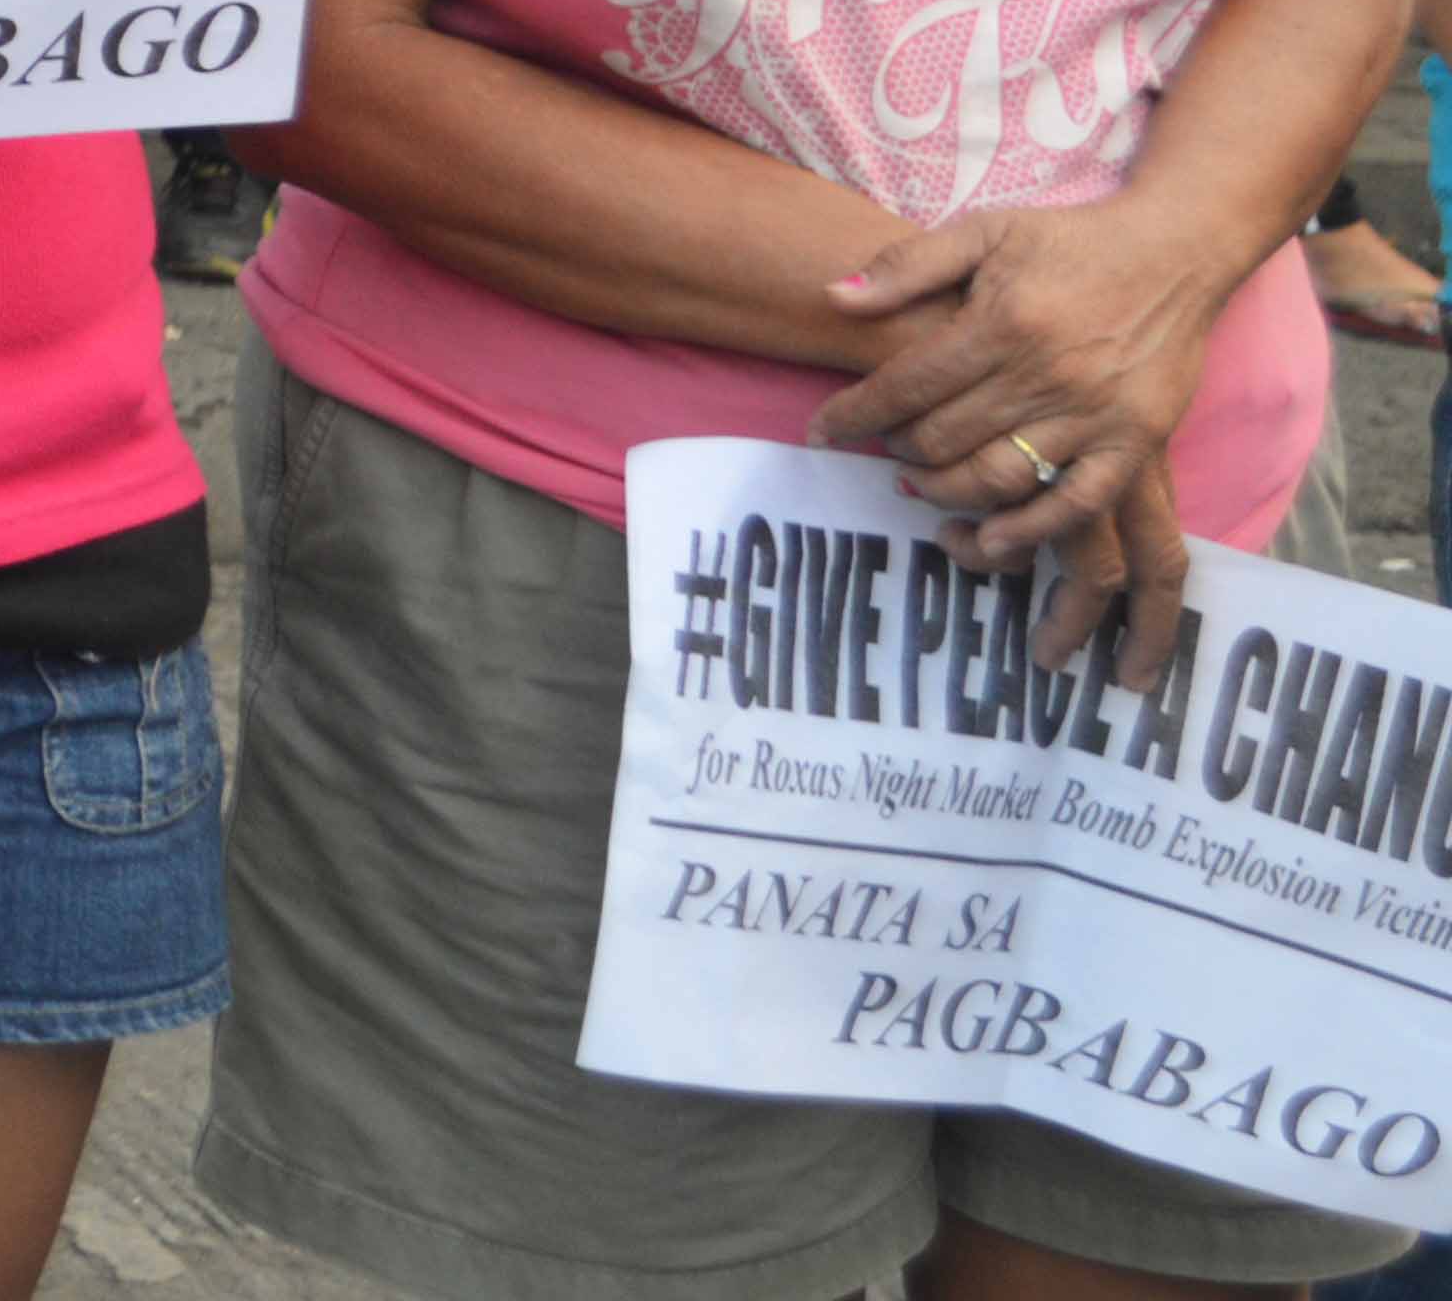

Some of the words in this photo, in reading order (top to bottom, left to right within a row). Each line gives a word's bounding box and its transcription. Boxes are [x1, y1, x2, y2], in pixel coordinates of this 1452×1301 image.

[674, 512, 890, 721] #GIVE
[661, 860, 924, 949] PANATA
[943, 891, 1025, 953] SA
[686, 734, 741, 795] for
[749, 743, 845, 800] Roxas
[850, 752, 934, 821] Night
[938, 763, 1046, 821] Market
[1049, 777, 1157, 852] Bomb
[1161, 811, 1344, 920] Explosion
[831, 971, 1441, 1179] PAGBABAGO
